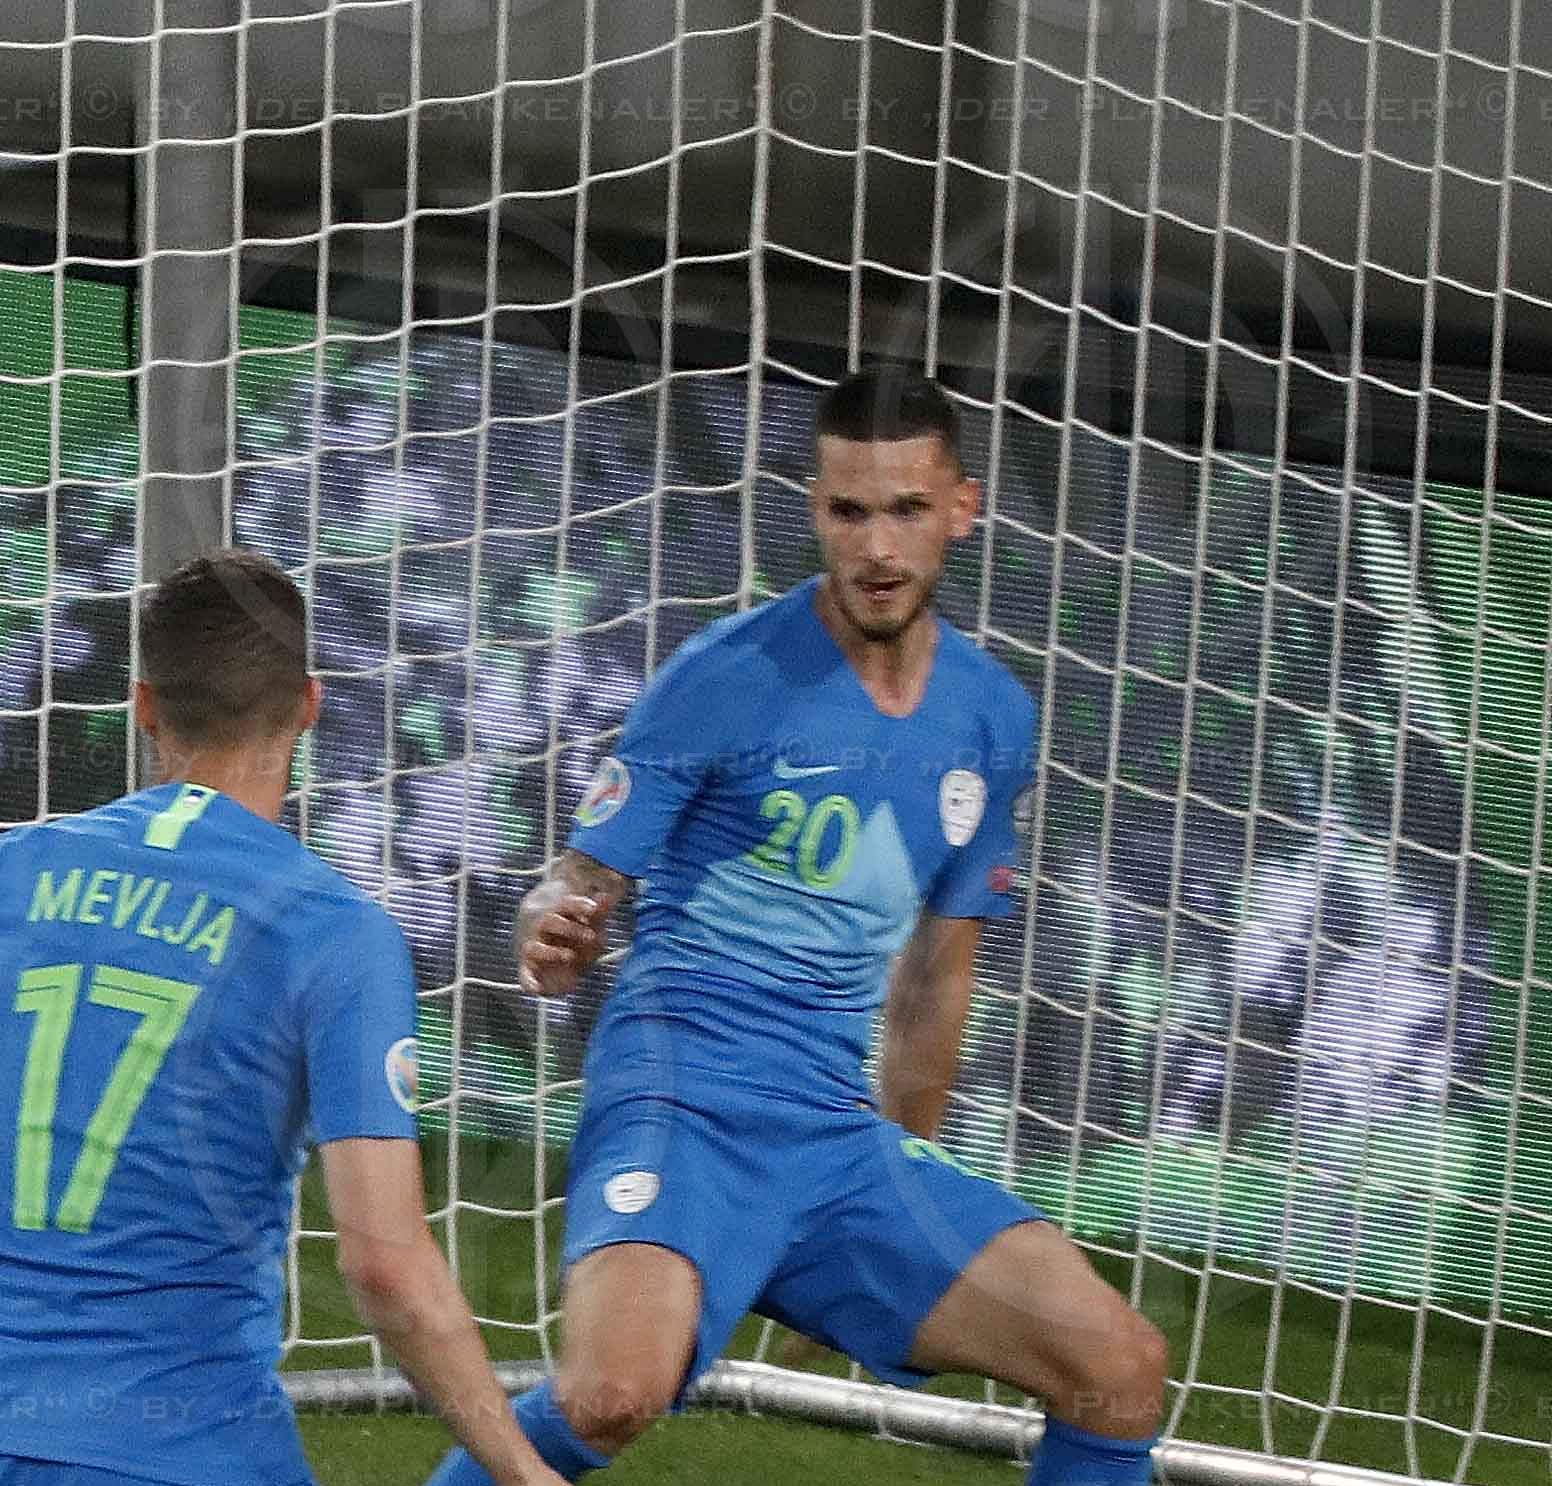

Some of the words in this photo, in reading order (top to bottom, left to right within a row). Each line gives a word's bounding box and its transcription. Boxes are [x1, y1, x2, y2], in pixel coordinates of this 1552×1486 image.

[742, 788, 862, 890] 20
[26, 868, 237, 968] MEVLJA
[13, 963, 203, 1235] 17
